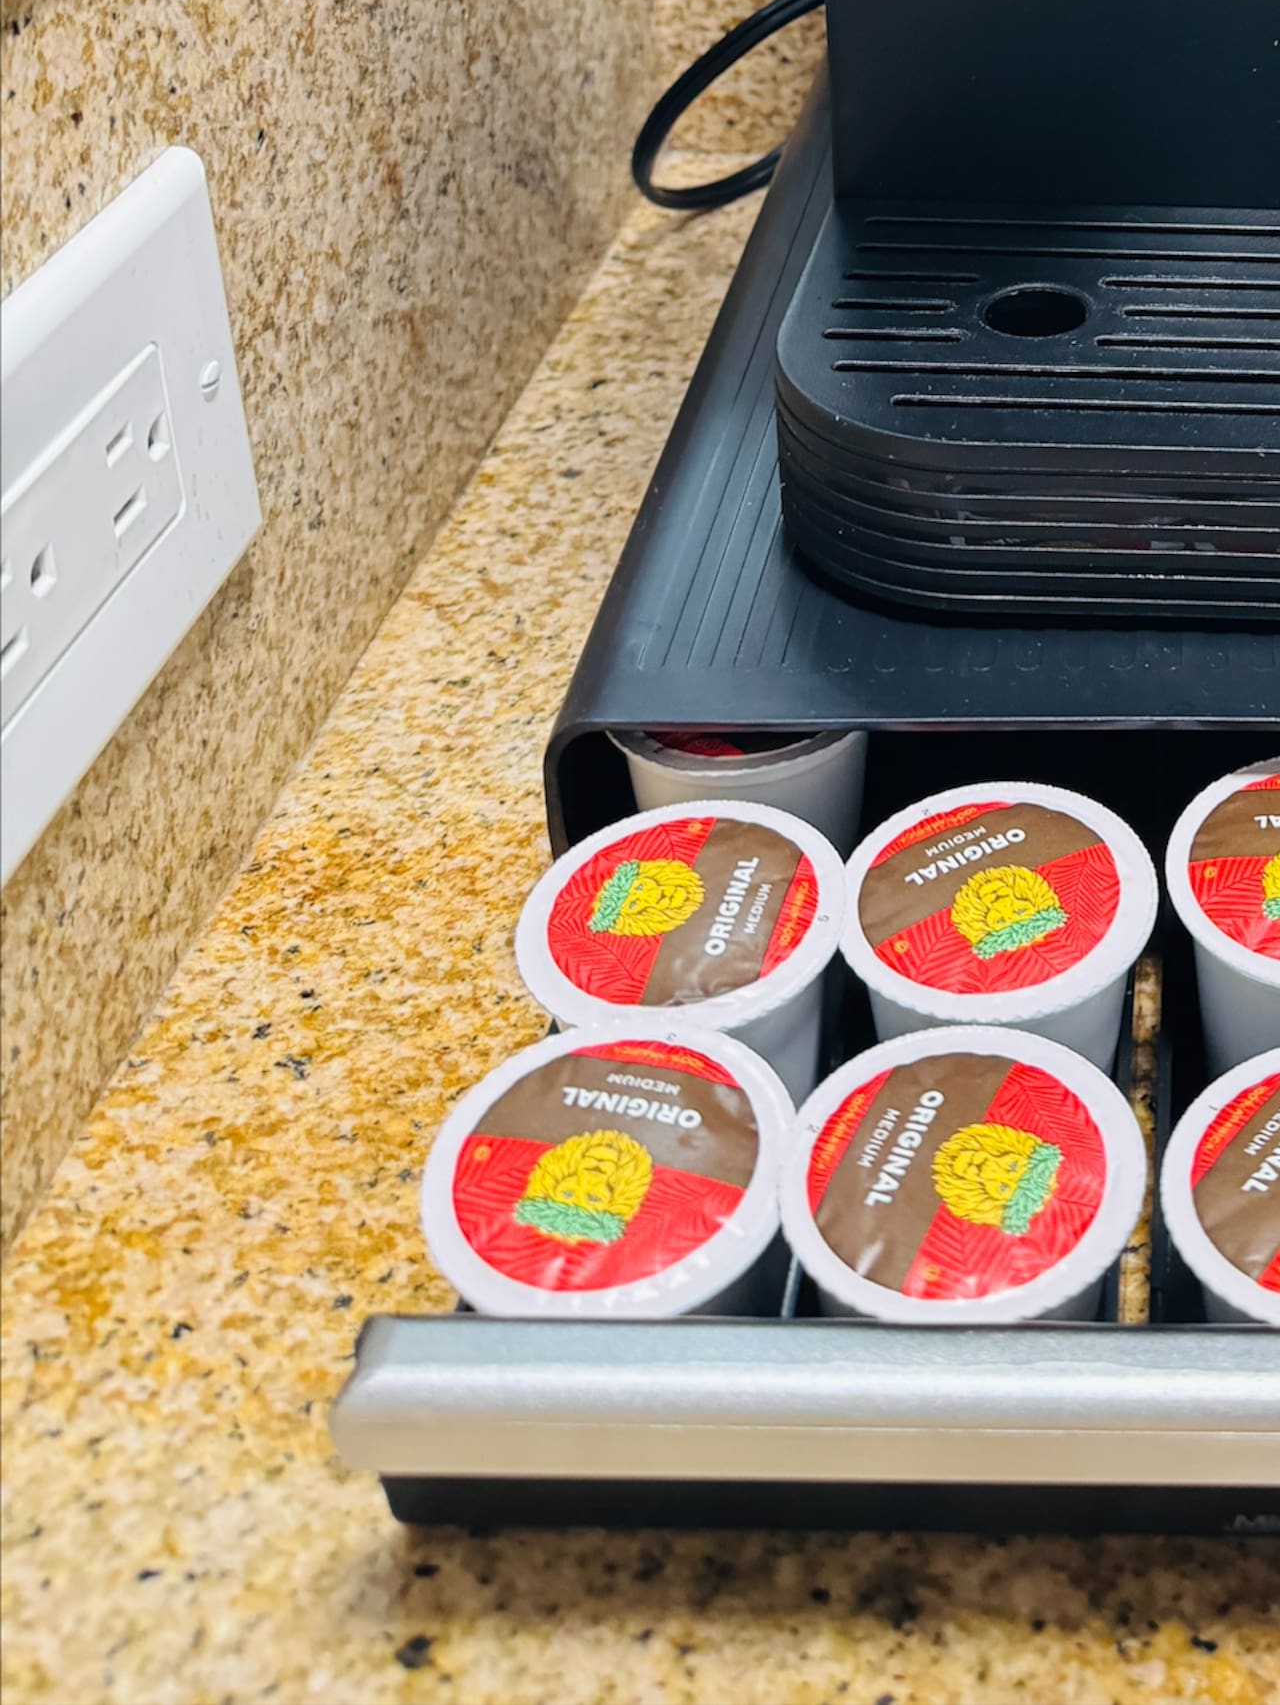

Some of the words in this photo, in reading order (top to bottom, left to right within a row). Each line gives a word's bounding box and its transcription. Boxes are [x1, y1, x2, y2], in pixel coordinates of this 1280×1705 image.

[904, 827, 1026, 887] ORIGINAL
[924, 825, 987, 857] MEDIUM
[704, 856, 759, 956] ORIGINAL
[744, 882, 773, 934] MEDIUM
[562, 1085, 703, 1130] ORIGINAL
[606, 1072, 681, 1097] MEDIUM
[857, 1108, 902, 1169] MEDIUM
[864, 1089, 945, 1207] ORIGINAL
